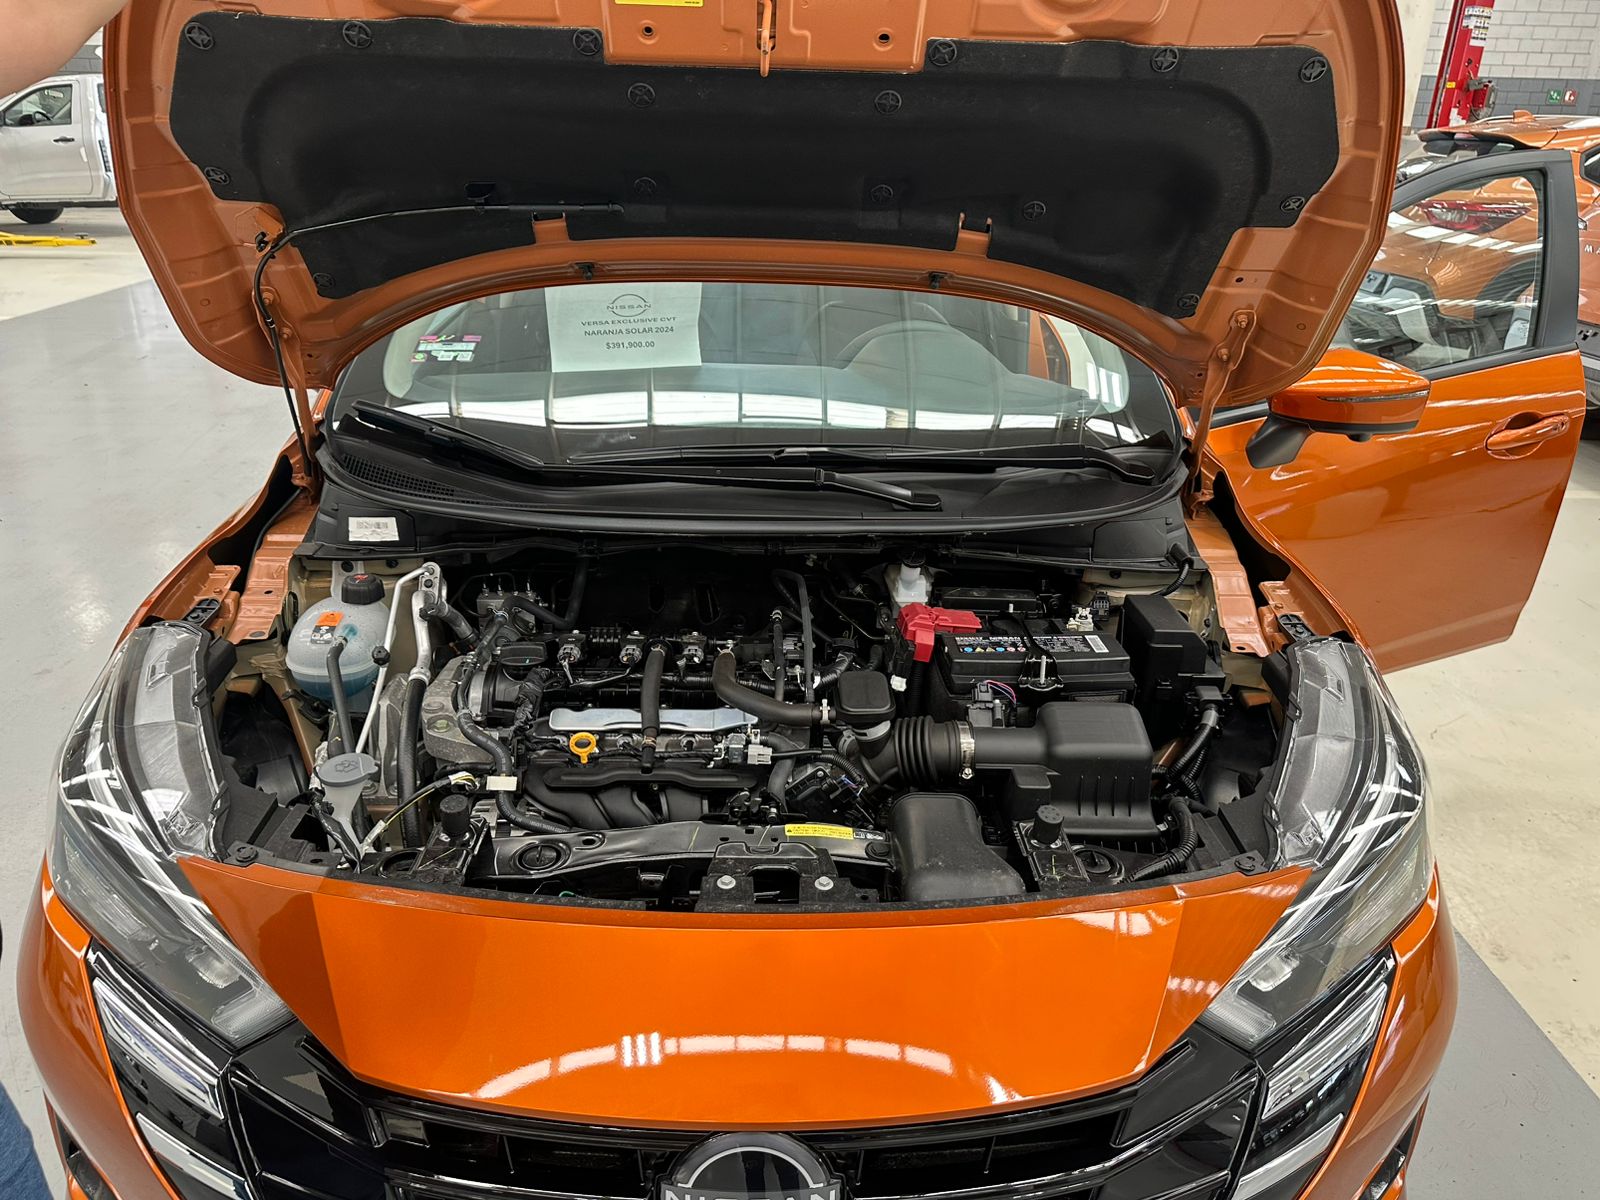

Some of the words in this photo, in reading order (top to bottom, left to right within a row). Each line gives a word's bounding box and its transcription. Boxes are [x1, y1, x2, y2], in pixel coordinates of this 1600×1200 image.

[611, 317, 658, 325] EXCLUSIVE
[584, 328, 624, 336] NARANJA
[625, 326, 653, 334] SOLAR
[606, 340, 655, 349] $391,900.00
